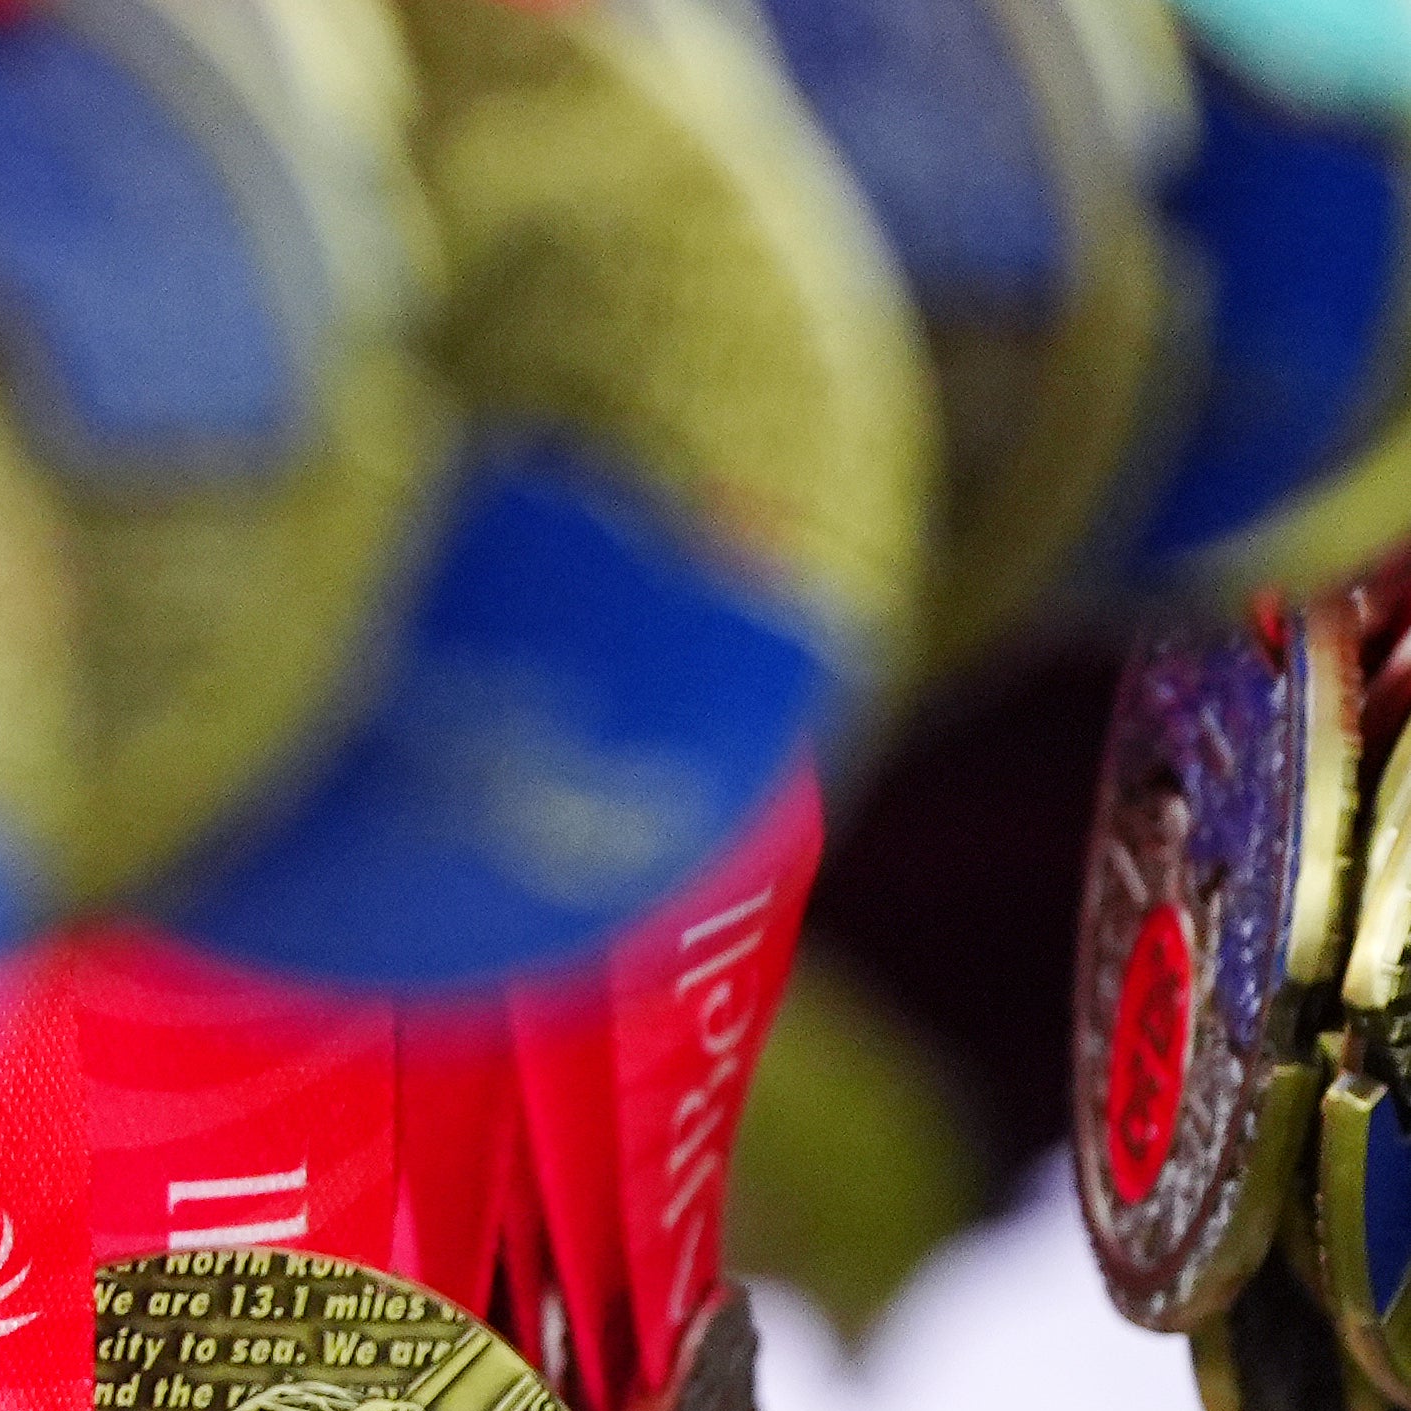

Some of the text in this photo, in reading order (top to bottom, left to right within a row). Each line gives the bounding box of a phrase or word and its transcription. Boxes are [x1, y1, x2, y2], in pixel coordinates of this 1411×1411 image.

[148, 1289, 211, 1318] are
[230, 1285, 310, 1319] 13.1
[323, 1284, 426, 1322] miles
[98, 1327, 166, 1371] city
[180, 1332, 217, 1364] to
[231, 1337, 307, 1367] sea.
[323, 1331, 379, 1367] We
[153, 1373, 214, 1410] the
